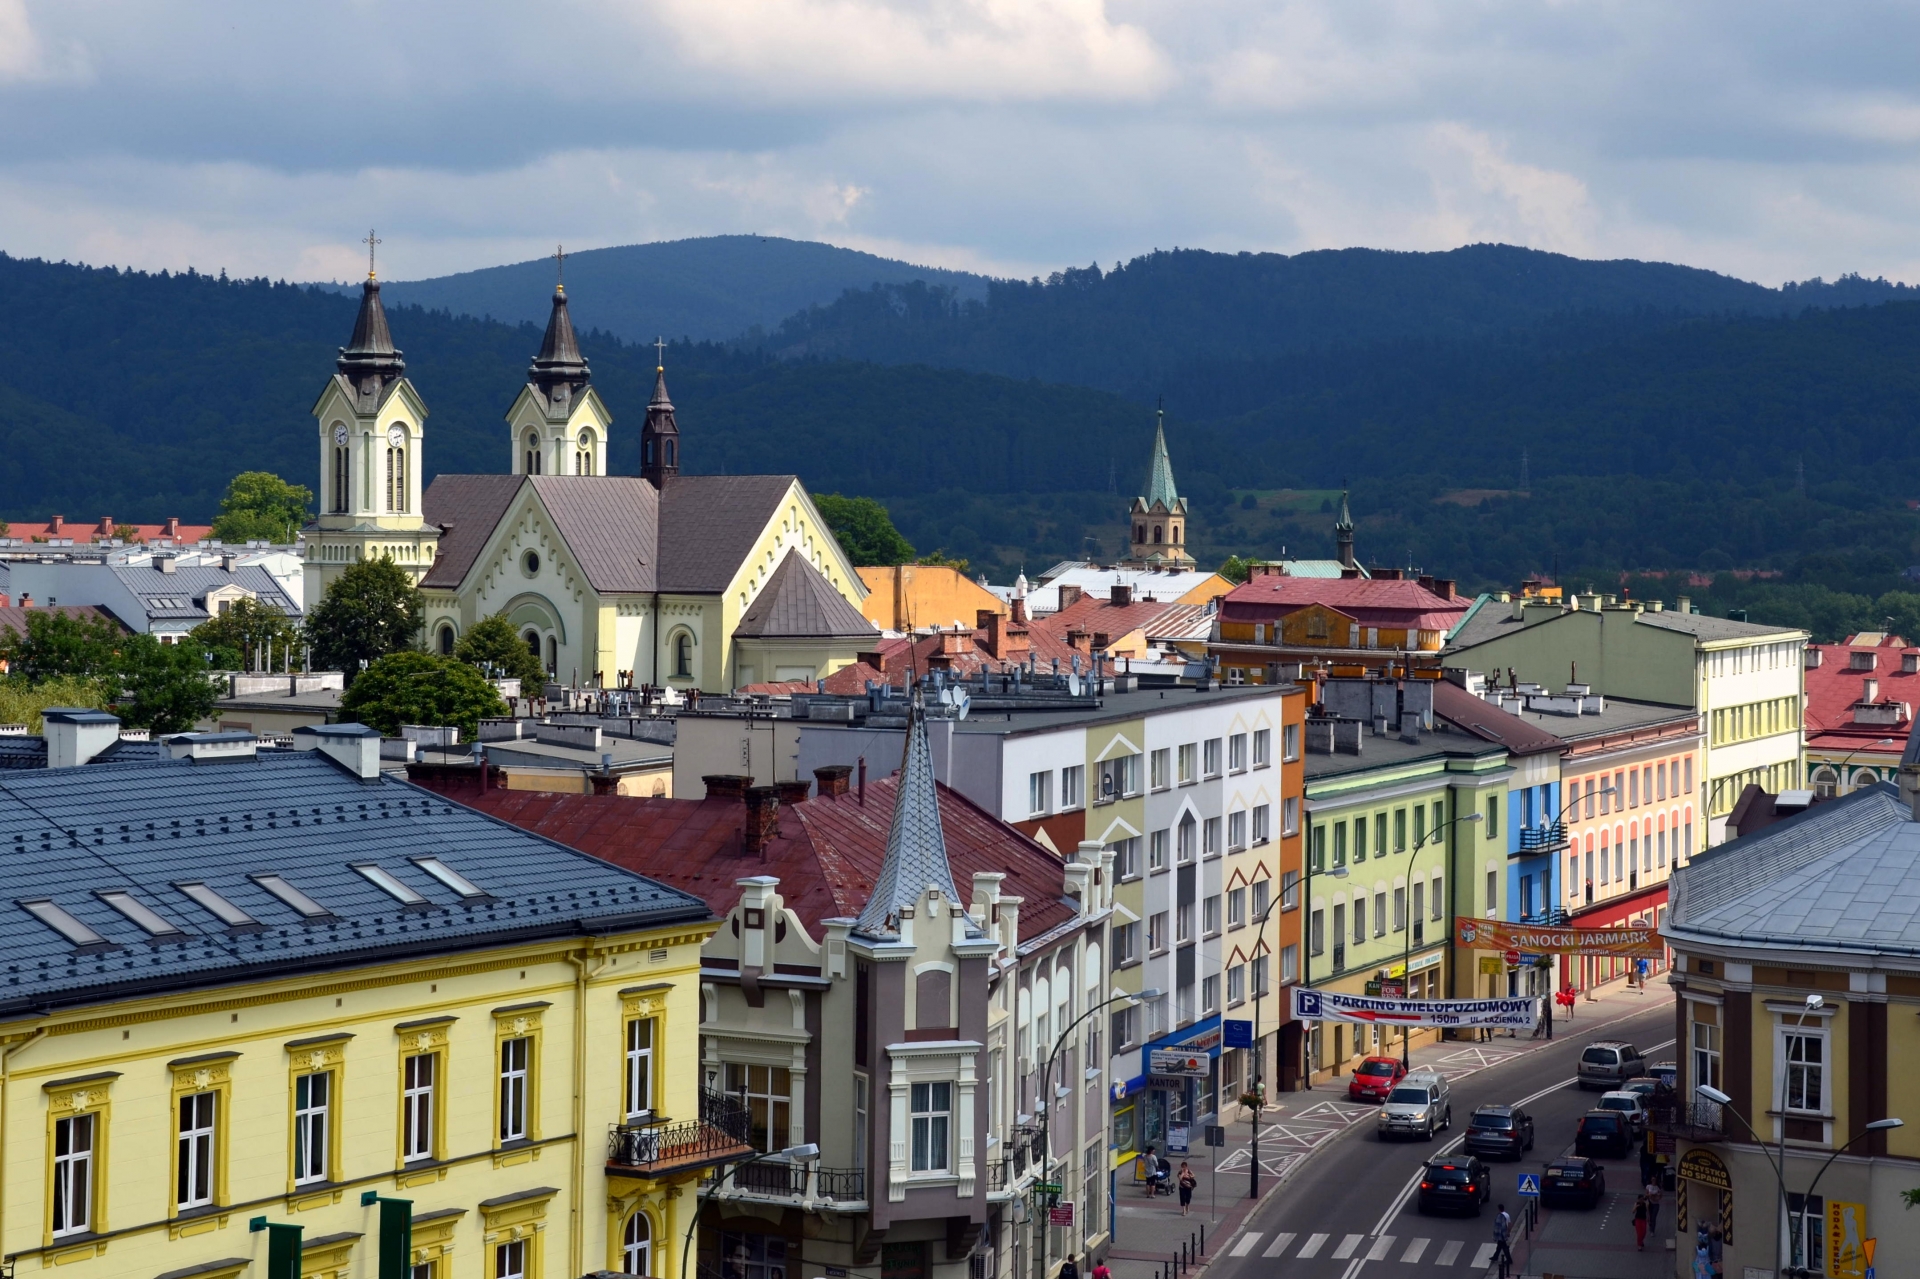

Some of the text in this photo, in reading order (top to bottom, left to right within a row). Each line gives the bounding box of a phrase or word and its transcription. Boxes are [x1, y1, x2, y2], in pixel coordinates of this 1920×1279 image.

[1510, 931, 1650, 948] SANOCKI JARMARK
[1304, 995, 1315, 1012] P
[1333, 995, 1532, 1013] PARKING WIELOPOZIOMOWY
[1430, 1014, 1460, 1024] 150m
[1470, 1016, 1482, 1024] UL.
[1525, 1016, 1531, 1024] 2
[1149, 1077, 1180, 1089] KANTOR
[1681, 1161, 1727, 1179] WSZYSTKO
[1681, 1168, 1694, 1178] DO
[1695, 1172, 1728, 1187] SPANIA
[1833, 1240, 1841, 1276] TRENDY
